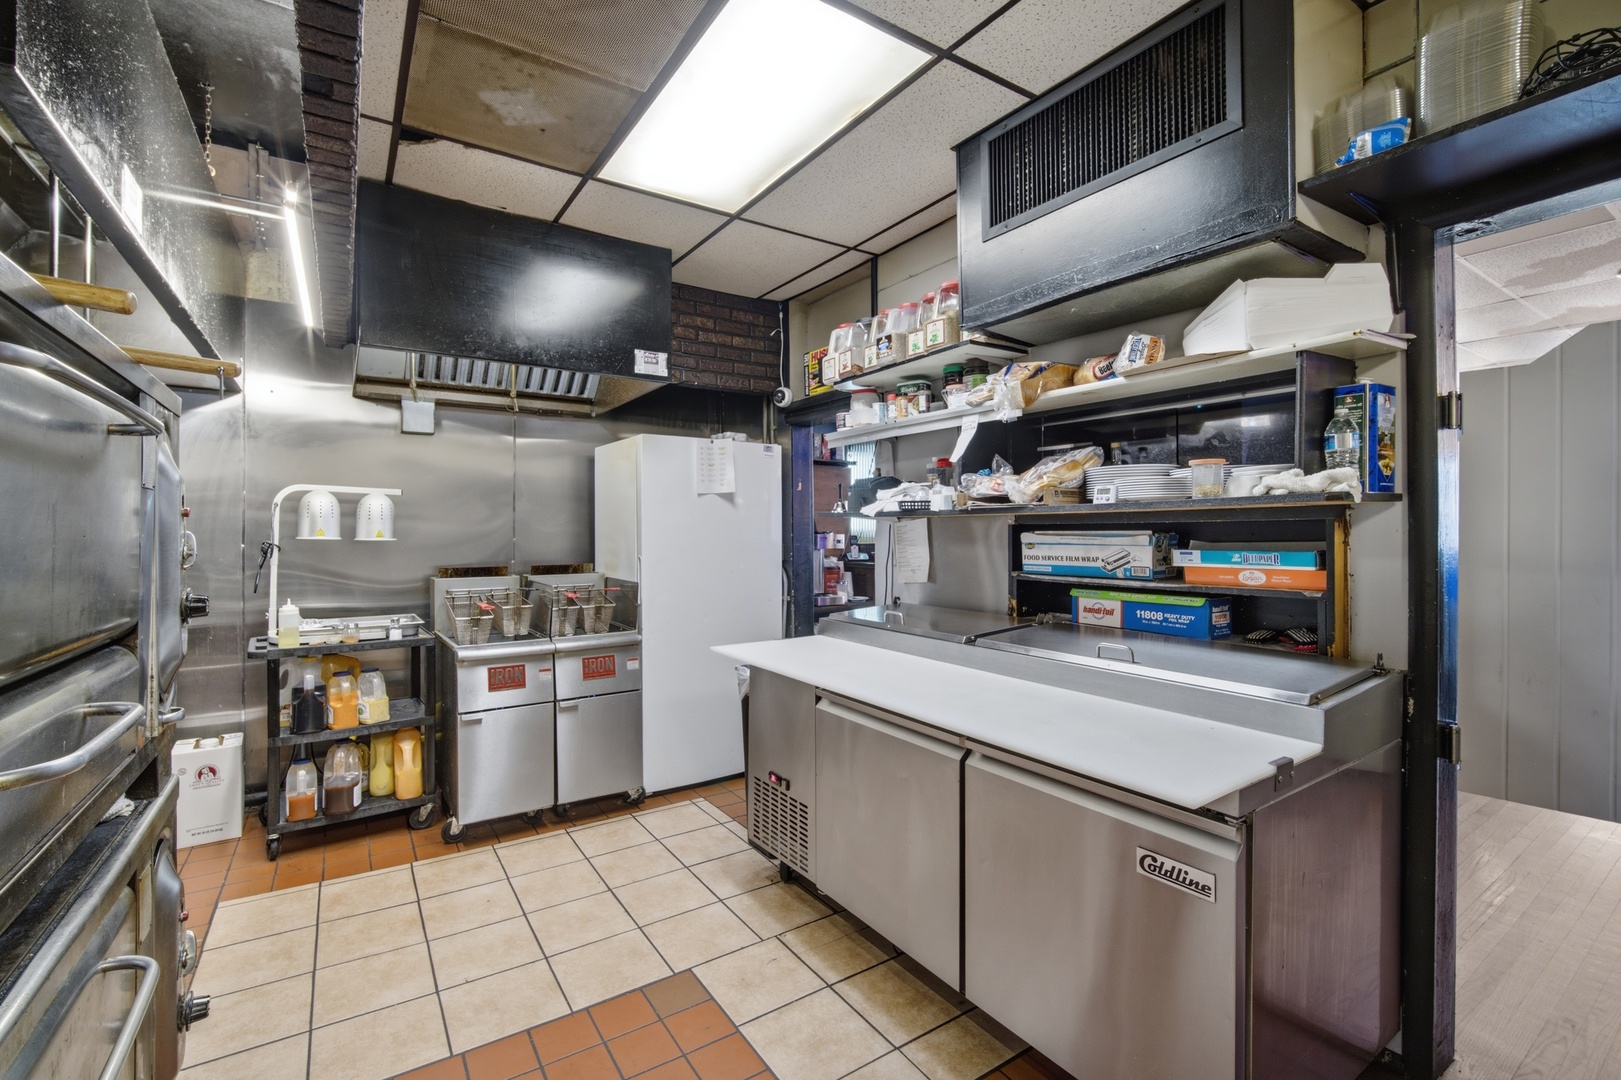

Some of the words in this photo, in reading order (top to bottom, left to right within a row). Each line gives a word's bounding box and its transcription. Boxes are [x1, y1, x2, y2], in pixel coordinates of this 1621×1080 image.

[1041, 554, 1064, 562] SERVICE
[1083, 605, 1115, 616] handi-foil
[1136, 609, 1164, 620] 11808
[584, 656, 614, 674] IRON
[490, 666, 524, 686] IRON
[1139, 854, 1212, 895] Coldline
